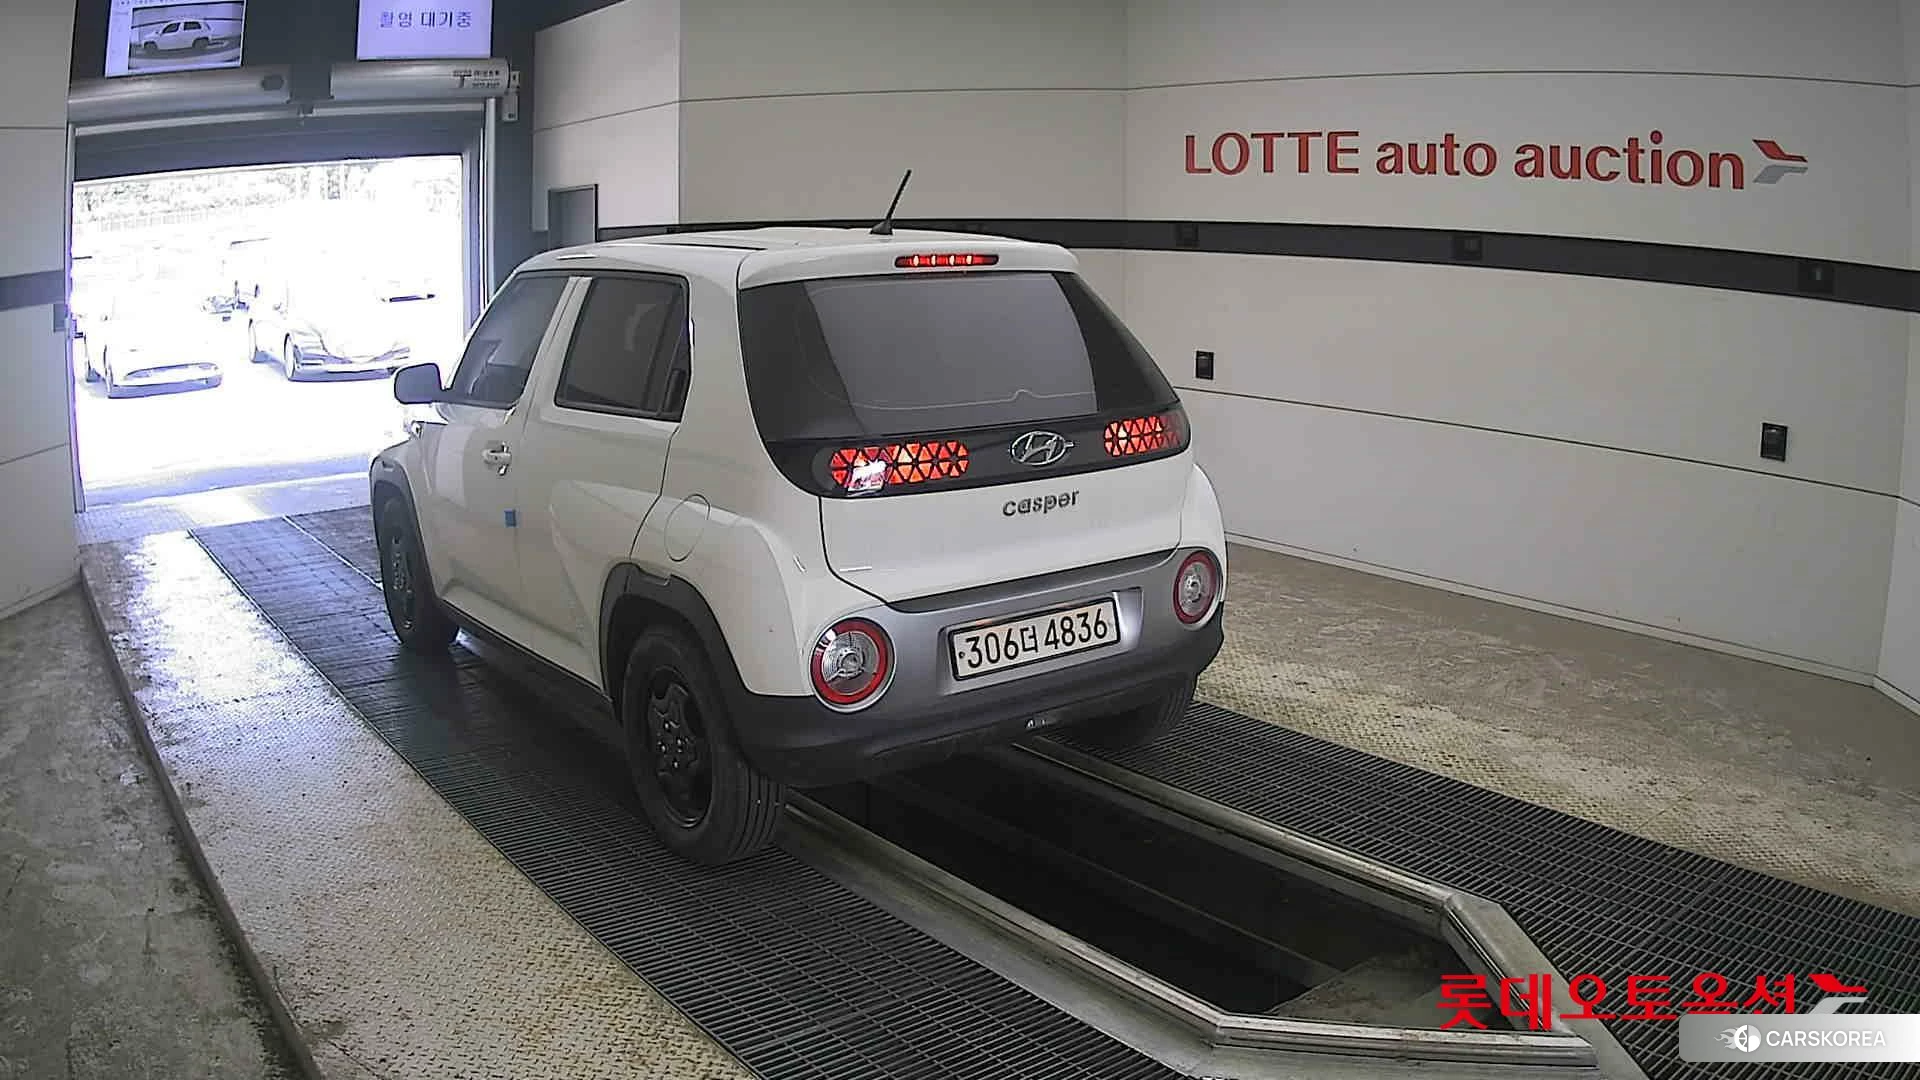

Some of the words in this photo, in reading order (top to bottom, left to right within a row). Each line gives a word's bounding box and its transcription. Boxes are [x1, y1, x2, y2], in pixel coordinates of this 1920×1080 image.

[1185, 131, 1360, 174] LOTTE
[1375, 134, 1497, 177] auto
[1513, 130, 1746, 189] auction
[1002, 489, 1080, 517] casper
[1044, 608, 1108, 650] 4836
